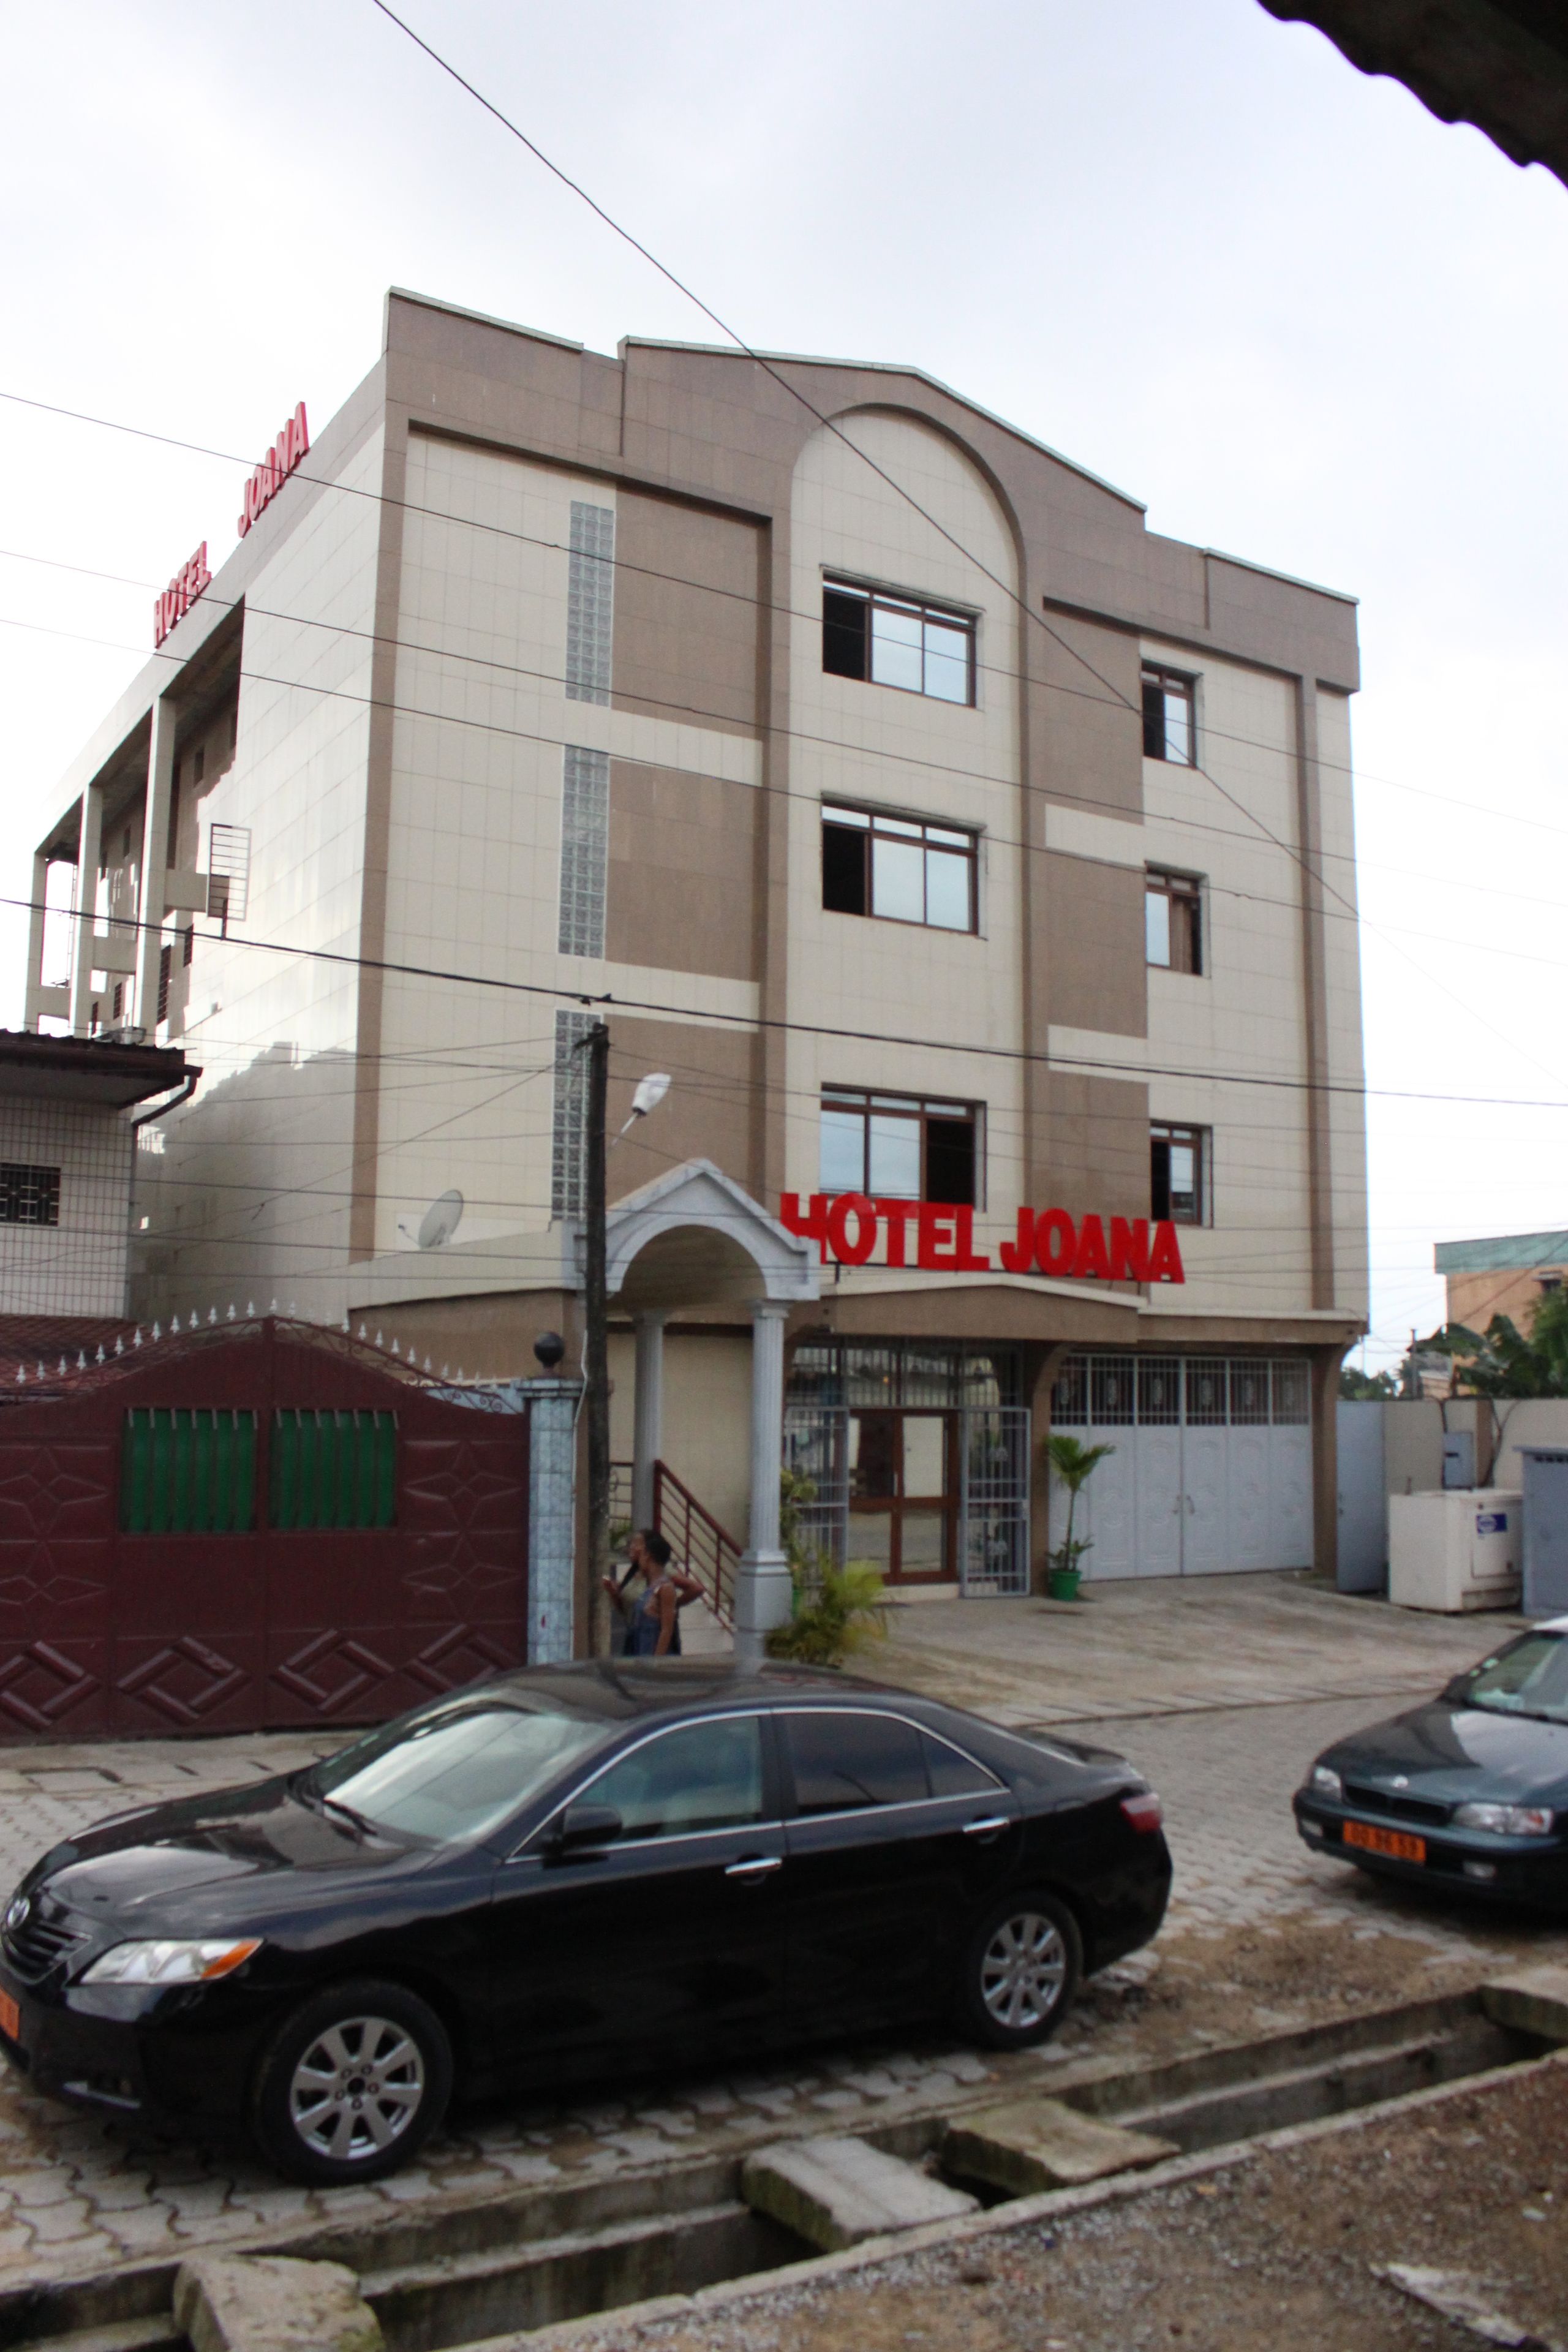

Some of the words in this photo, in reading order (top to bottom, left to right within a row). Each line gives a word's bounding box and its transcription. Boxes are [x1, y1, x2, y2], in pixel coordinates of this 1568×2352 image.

[154, 541, 212, 649] HOTEL
[238, 401, 310, 538] JOANA
[780, 1192, 990, 1272] HOTEL
[1000, 1207, 1185, 1284] JOANA
